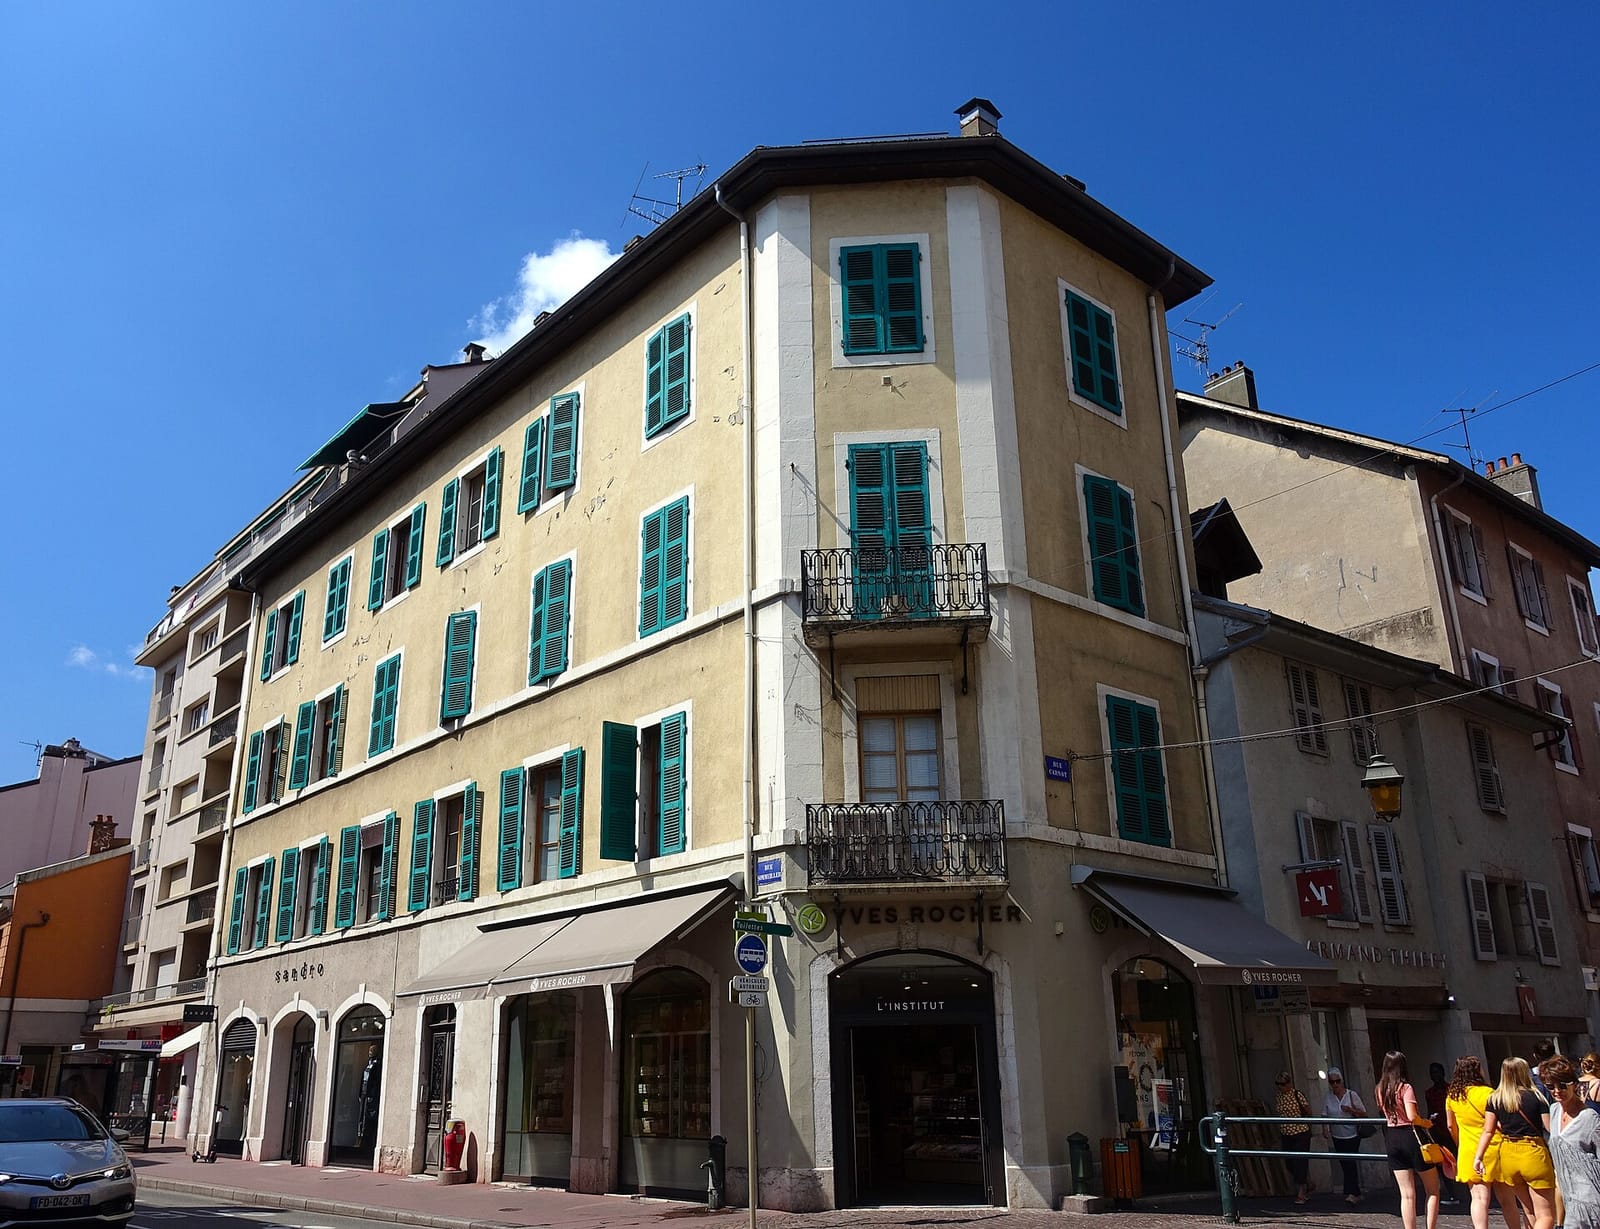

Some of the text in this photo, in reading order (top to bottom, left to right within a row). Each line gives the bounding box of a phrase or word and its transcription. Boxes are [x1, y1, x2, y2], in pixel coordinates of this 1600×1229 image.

[1052, 761, 1063, 769] RUE
[833, 904, 1021, 924] YVES ROCHER
[736, 921, 764, 931] Toilettes
[275, 962, 324, 983] sandro
[1252, 972, 1302, 983] YVES ROCHER
[539, 975, 586, 989] YVES ROCHER
[425, 991, 461, 1004] YVES ROCHER
[877, 1001, 945, 1011] L'INSTITUT
